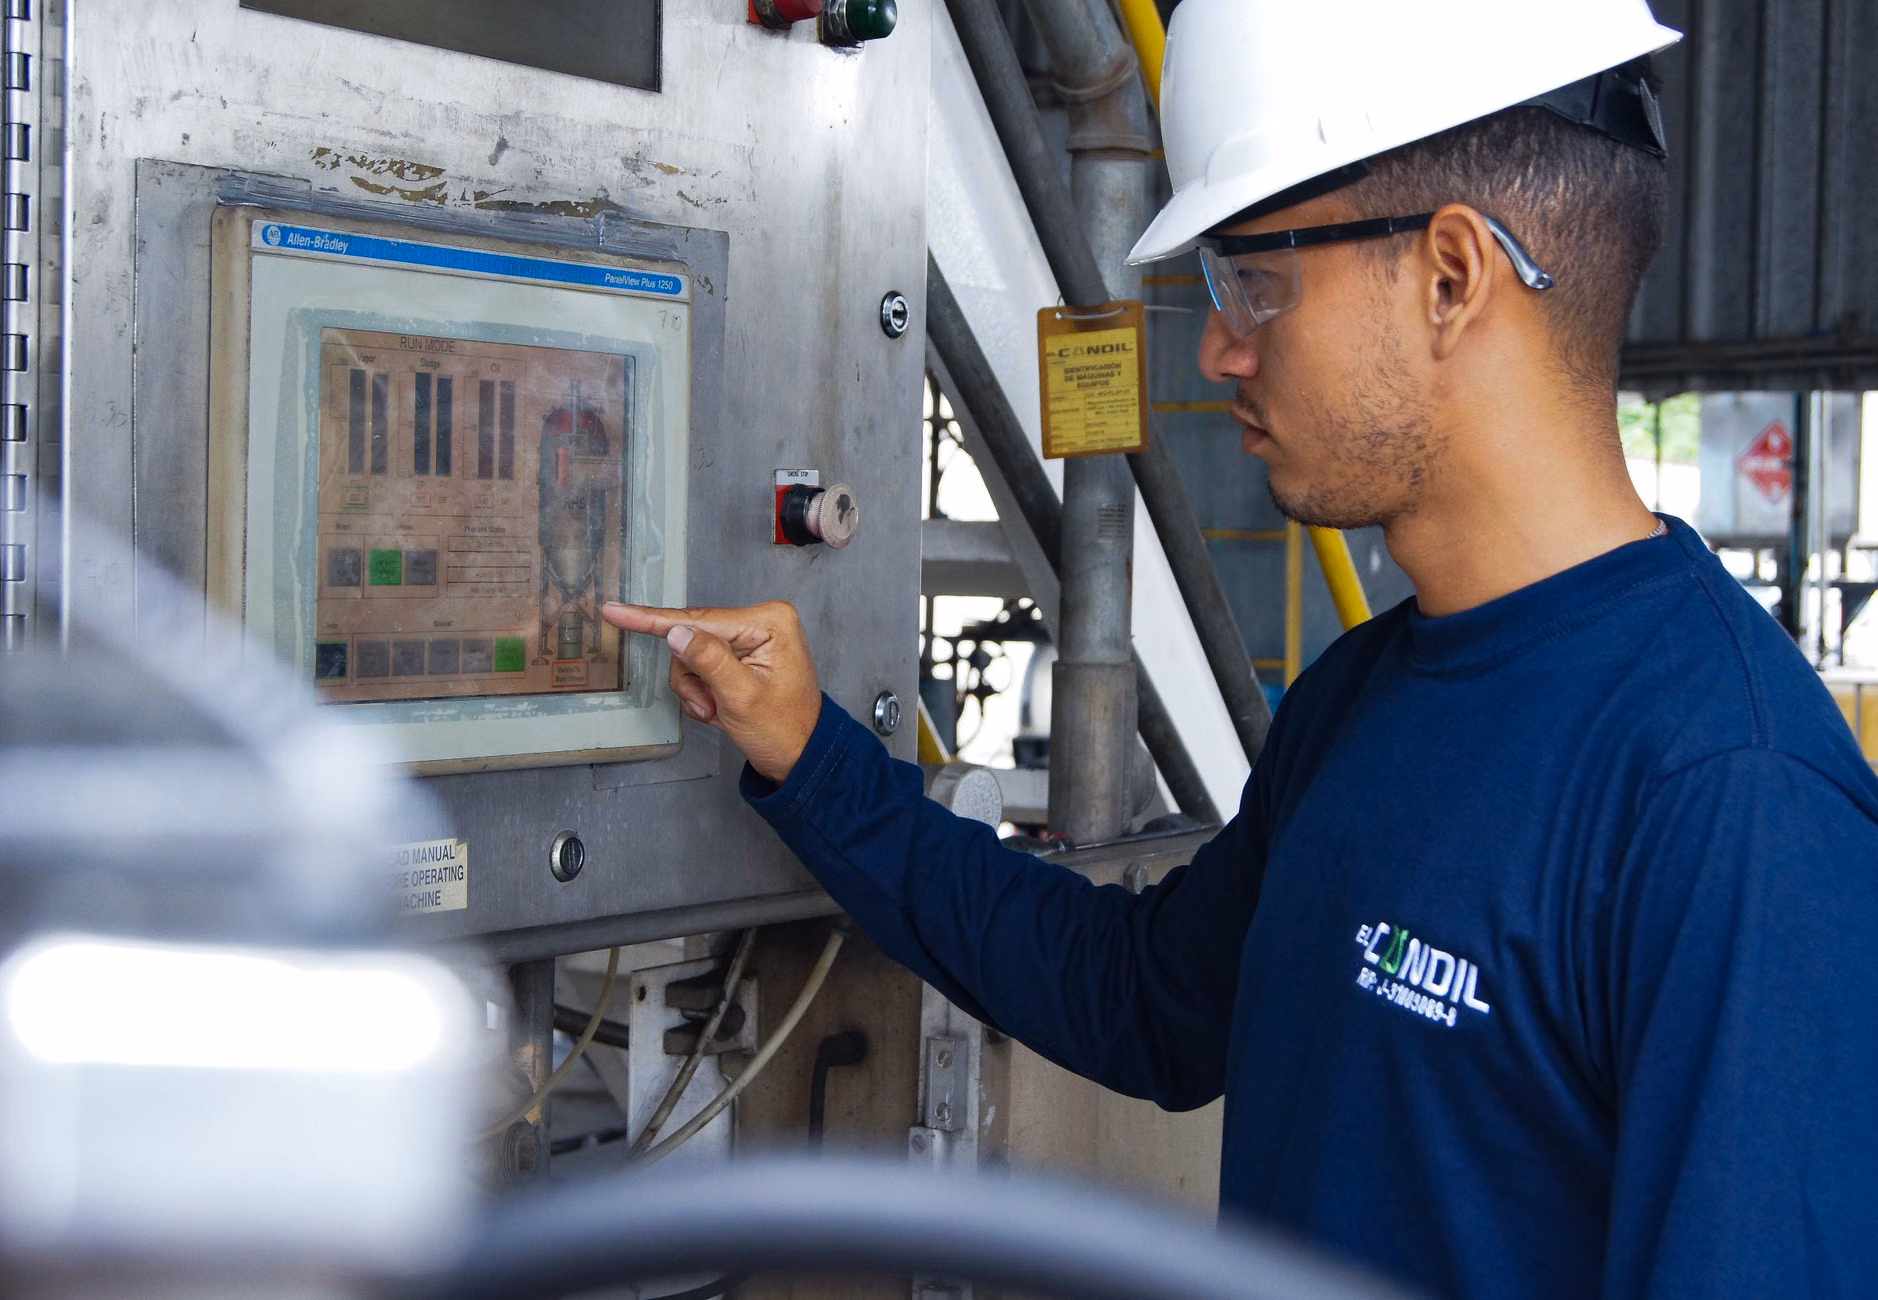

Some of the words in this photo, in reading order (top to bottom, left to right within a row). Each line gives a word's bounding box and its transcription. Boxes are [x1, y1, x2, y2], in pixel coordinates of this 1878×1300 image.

[287, 232, 349, 254] Allen-Bradley
[605, 273, 640, 286] PanelView
[641, 277, 656, 289] Plus
[658, 279, 674, 290] 1250
[400, 336, 423, 350] RUN
[425, 338, 456, 353] MODE
[1058, 343, 1133, 358] CANDIL
[357, 352, 376, 364] Vapor
[420, 357, 441, 370] Sludge
[412, 844, 456, 864] MANUAL
[412, 864, 464, 887] OPERATING
[402, 890, 441, 910] ACHINE
[1363, 922, 1490, 1013] CANDIL
